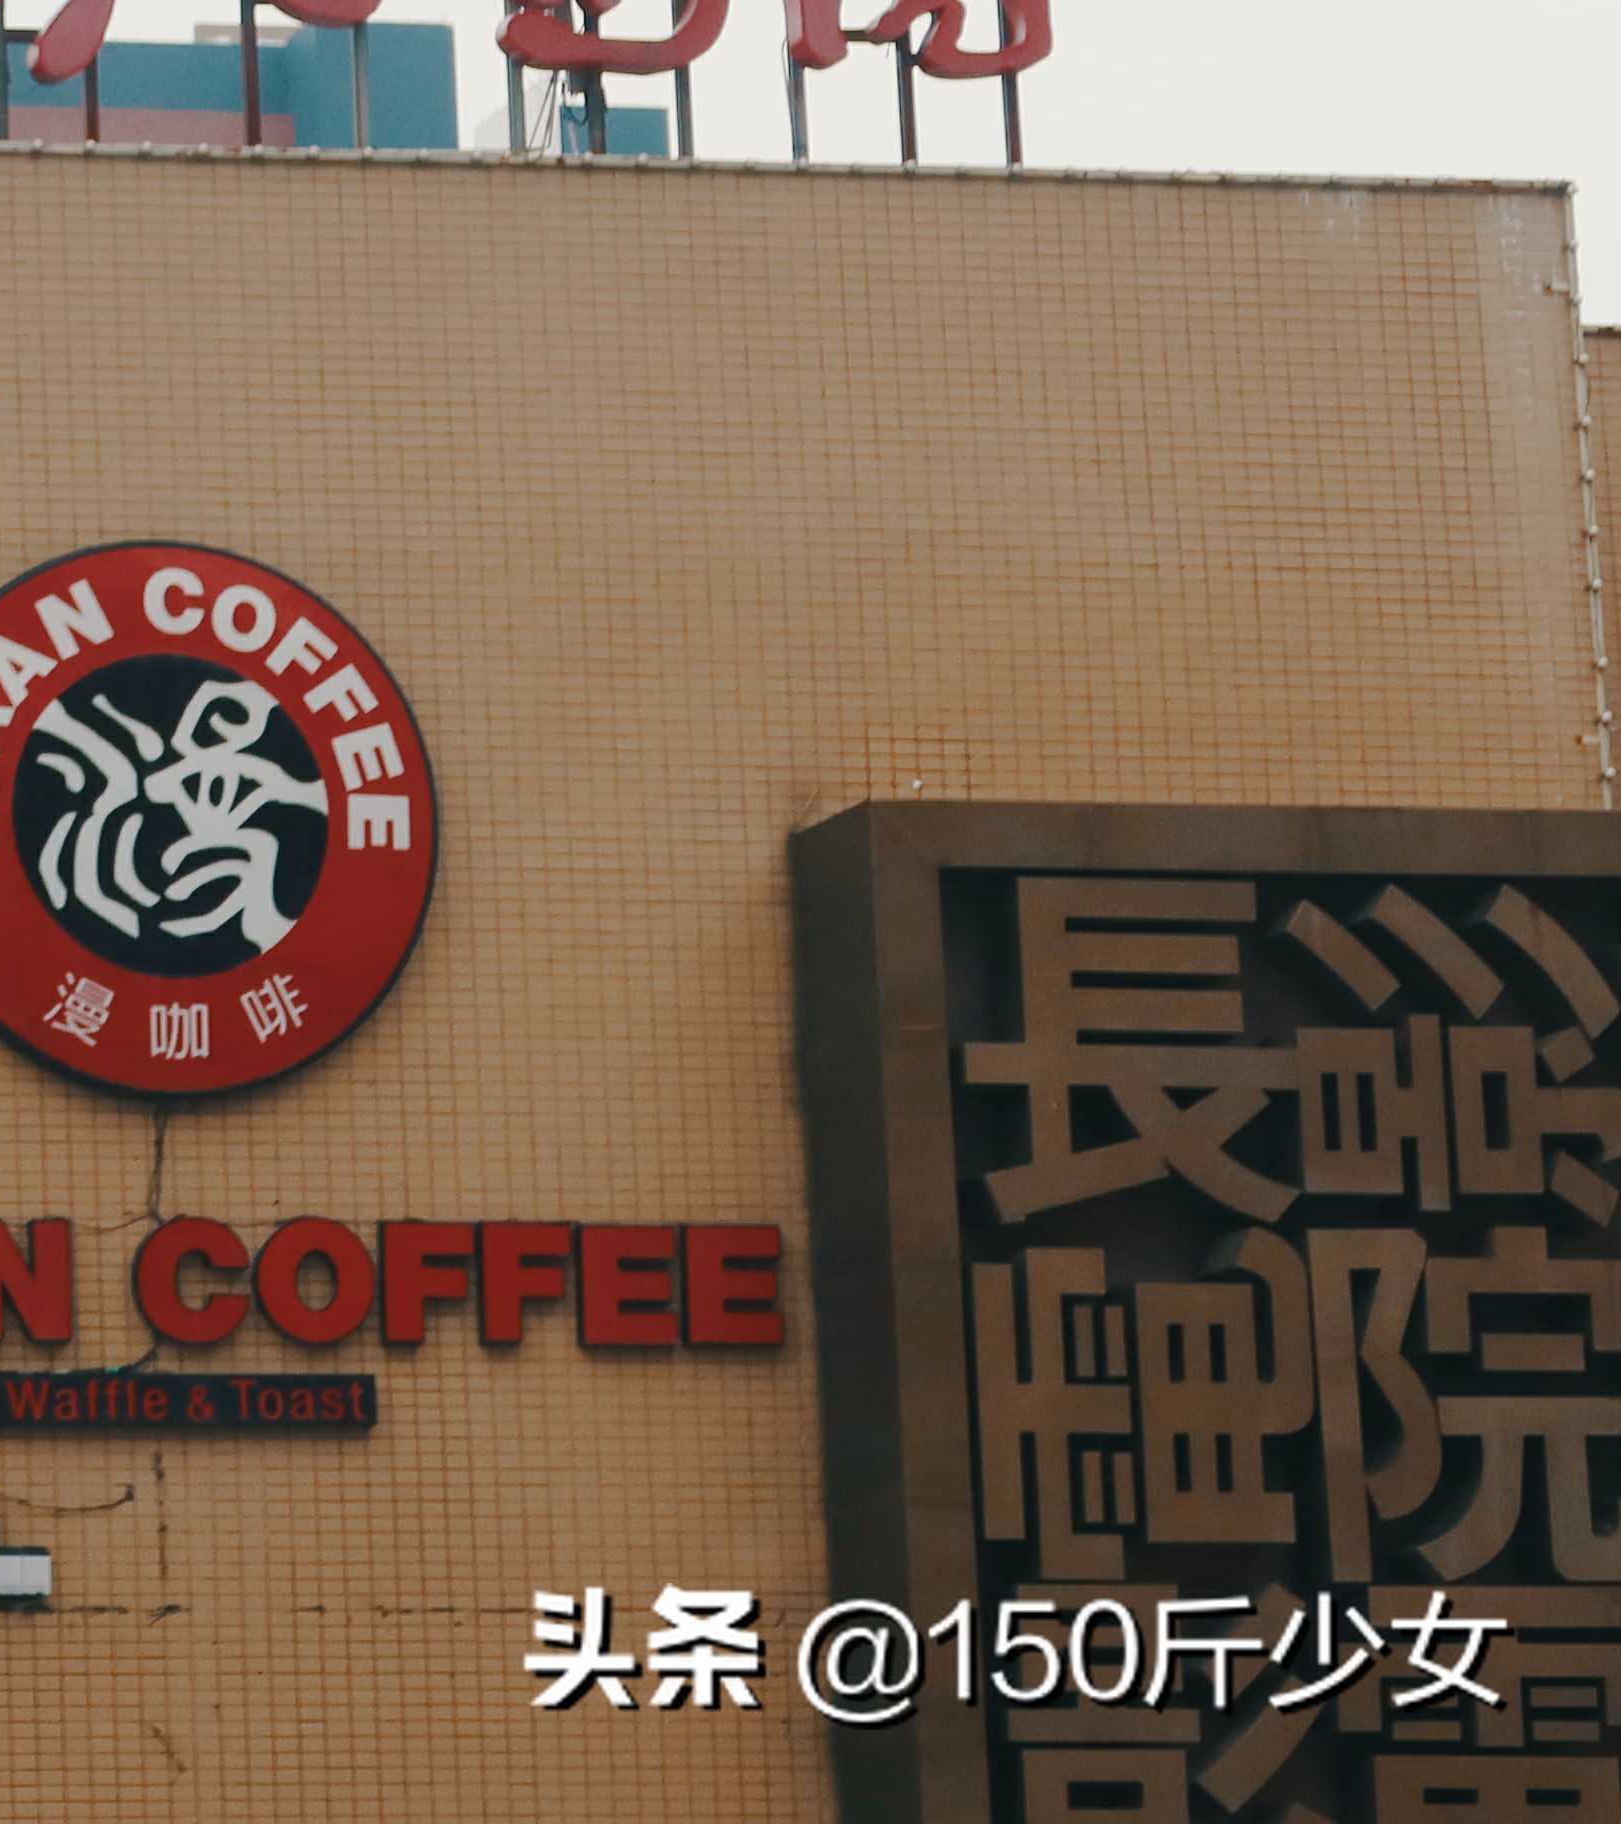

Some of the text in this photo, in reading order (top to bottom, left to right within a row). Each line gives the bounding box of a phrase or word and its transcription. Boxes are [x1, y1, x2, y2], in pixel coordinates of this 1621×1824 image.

[143, 566, 412, 851] COFFEE
[43, 972, 309, 1060] 漫咖啡
[133, 1216, 786, 1347] COFFEE
[4, 1378, 366, 1422] Waffle & Toast
